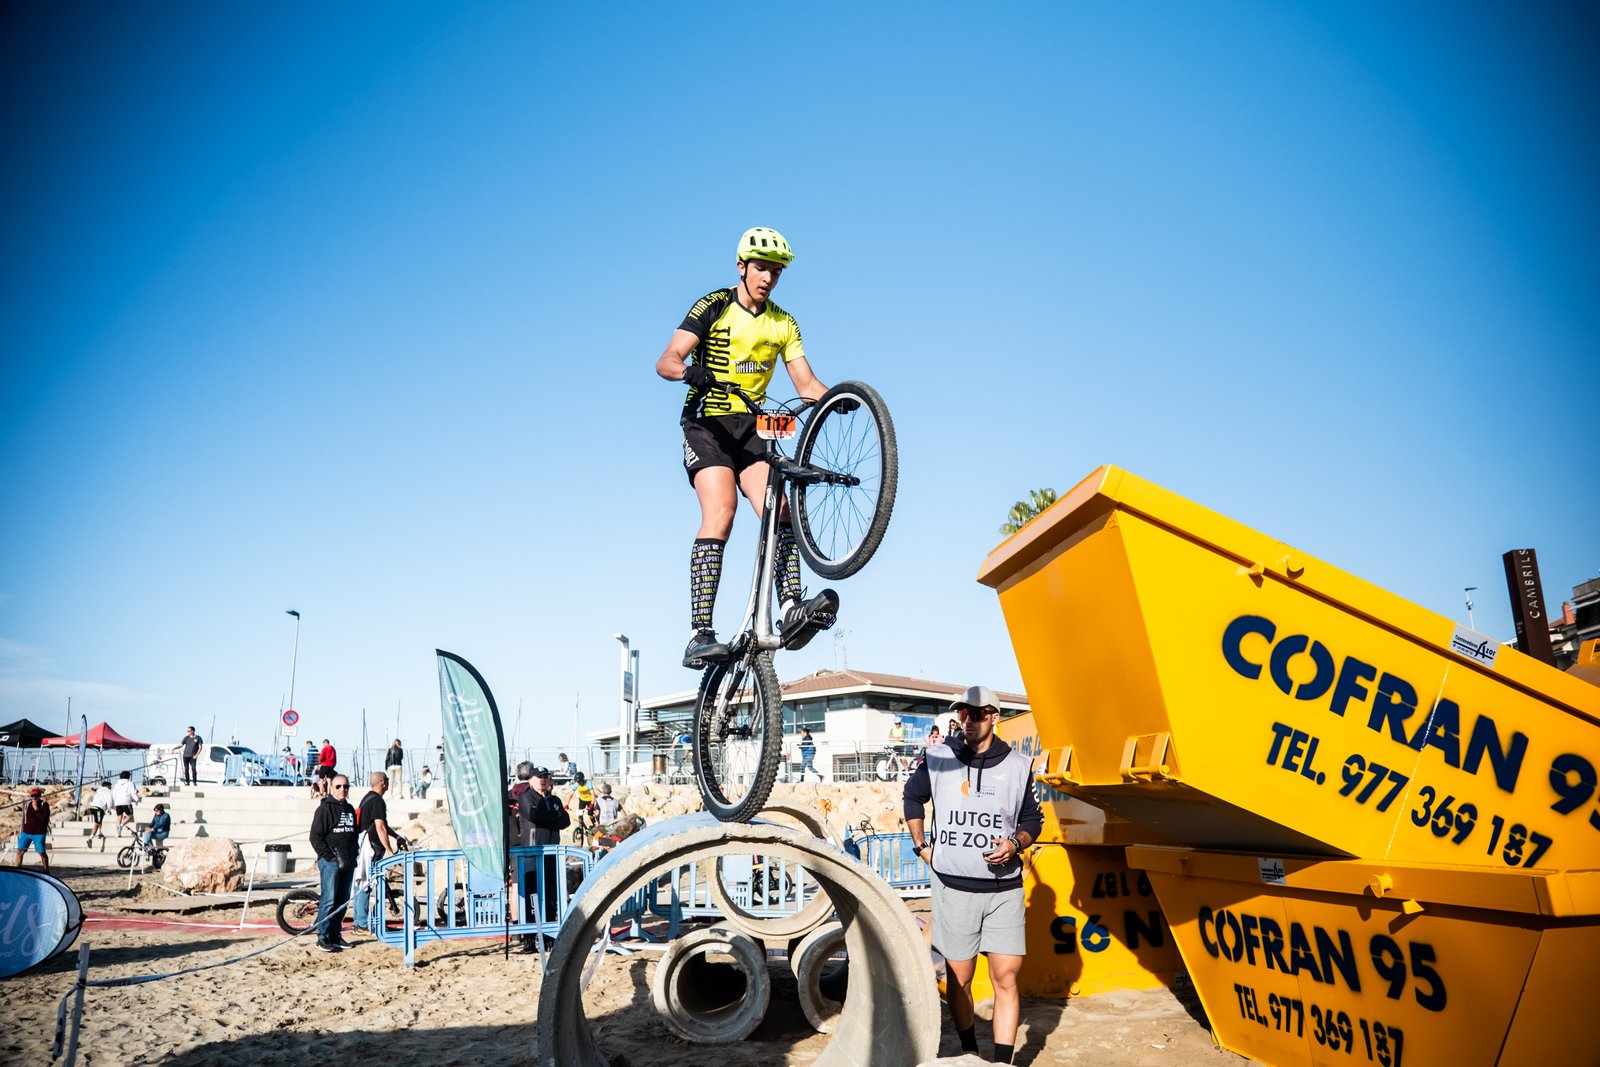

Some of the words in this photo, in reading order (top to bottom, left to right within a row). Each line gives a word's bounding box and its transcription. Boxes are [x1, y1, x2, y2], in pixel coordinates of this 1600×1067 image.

[765, 416, 789, 431] 117
[1519, 549, 1540, 619] CAMBRILS
[1221, 614, 1530, 794] COFRAN
[948, 810, 1003, 829] JUTGE
[1266, 721, 1326, 786] TEL.
[1339, 753, 1410, 813] 977
[1411, 785, 1478, 846] 369
[1487, 815, 1553, 868] 187
[940, 830, 957, 846] DE
[962, 832, 1004, 850] ZON
[1050, 915, 1111, 954] 95
[1198, 906, 1362, 993] COFRAN
[1369, 933, 1448, 1012] 95
[1234, 983, 1269, 1028] TEL.
[1268, 992, 1304, 1038] 977
[1310, 1003, 1353, 1055] 369
[1359, 1018, 1404, 1067] 187
